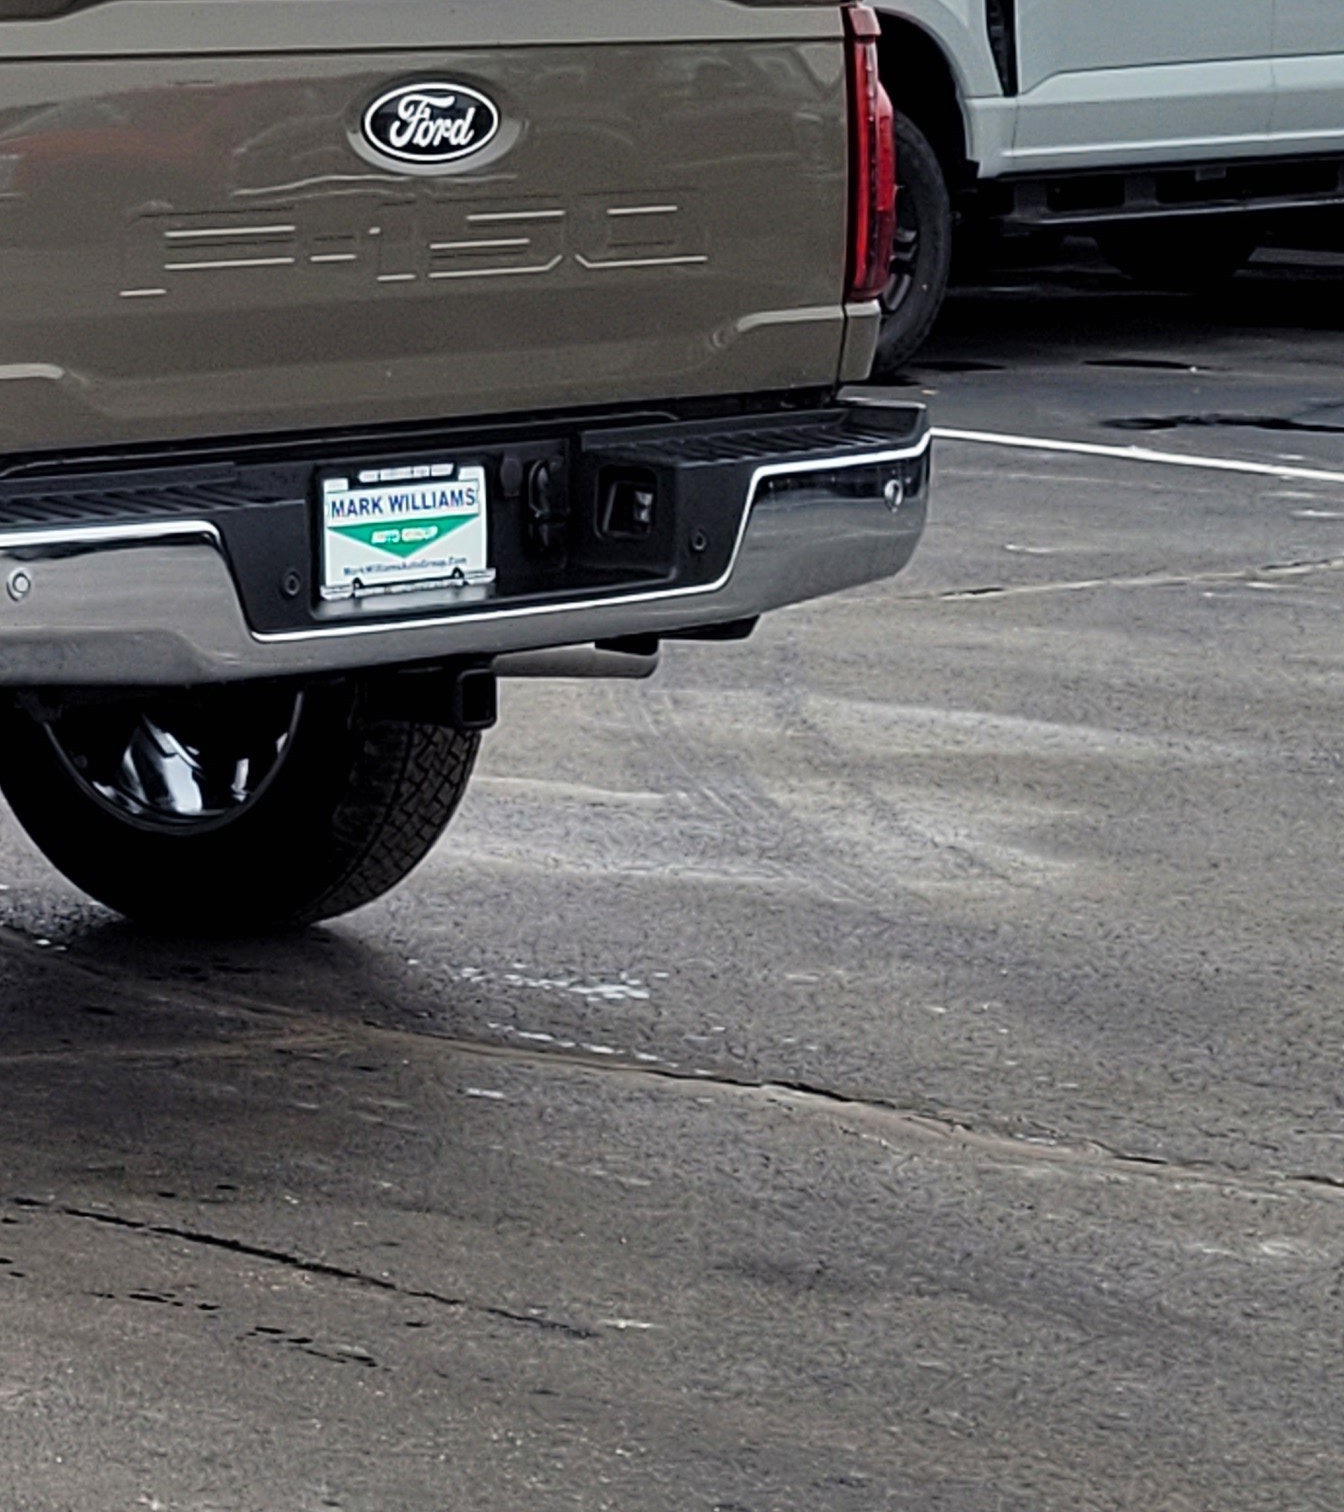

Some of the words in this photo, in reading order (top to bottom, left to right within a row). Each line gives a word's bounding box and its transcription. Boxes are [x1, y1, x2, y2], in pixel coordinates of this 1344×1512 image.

[389, 93, 476, 148] Ford
[120, 189, 708, 296] F-150
[331, 495, 384, 519] MARK
[388, 487, 477, 513] WILLIAMS
